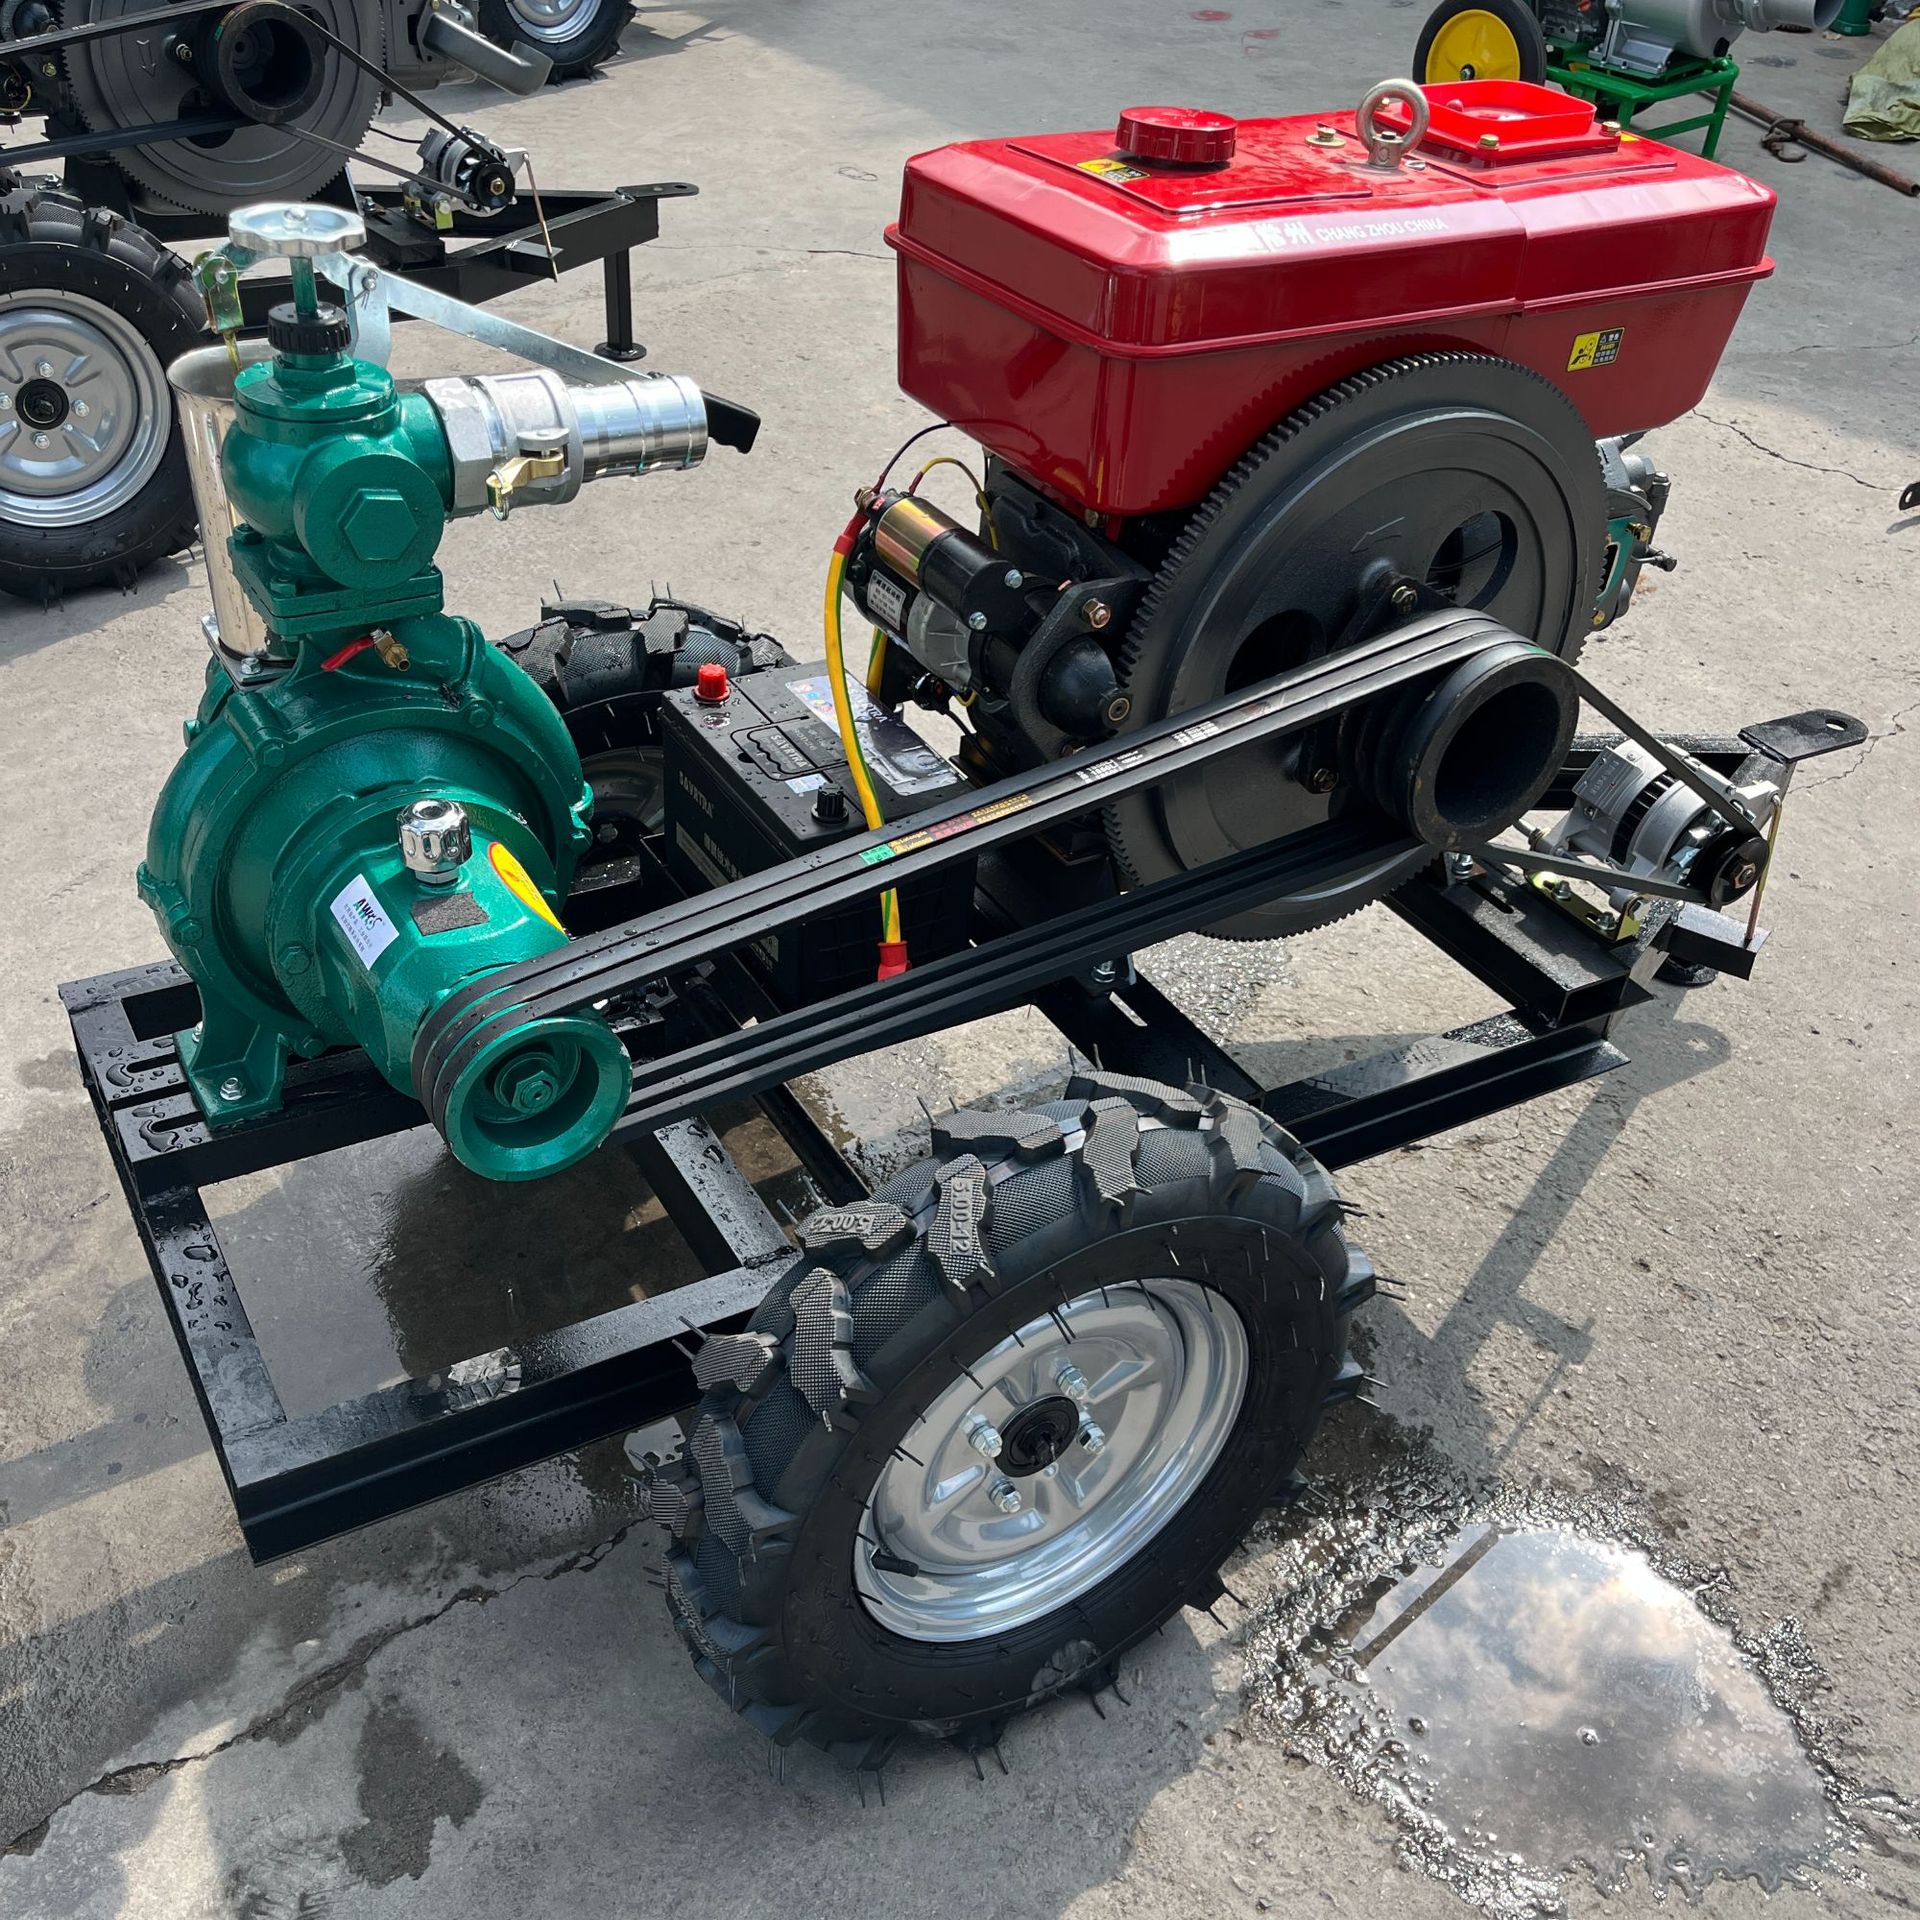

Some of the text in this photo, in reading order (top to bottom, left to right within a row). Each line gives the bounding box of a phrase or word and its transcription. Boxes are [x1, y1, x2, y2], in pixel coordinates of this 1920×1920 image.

[1315, 217, 1449, 242] CHANG ZHOU CHINA
[811, 1212, 874, 1232] 5.00-12
[952, 1178, 973, 1255] 5.00-12
